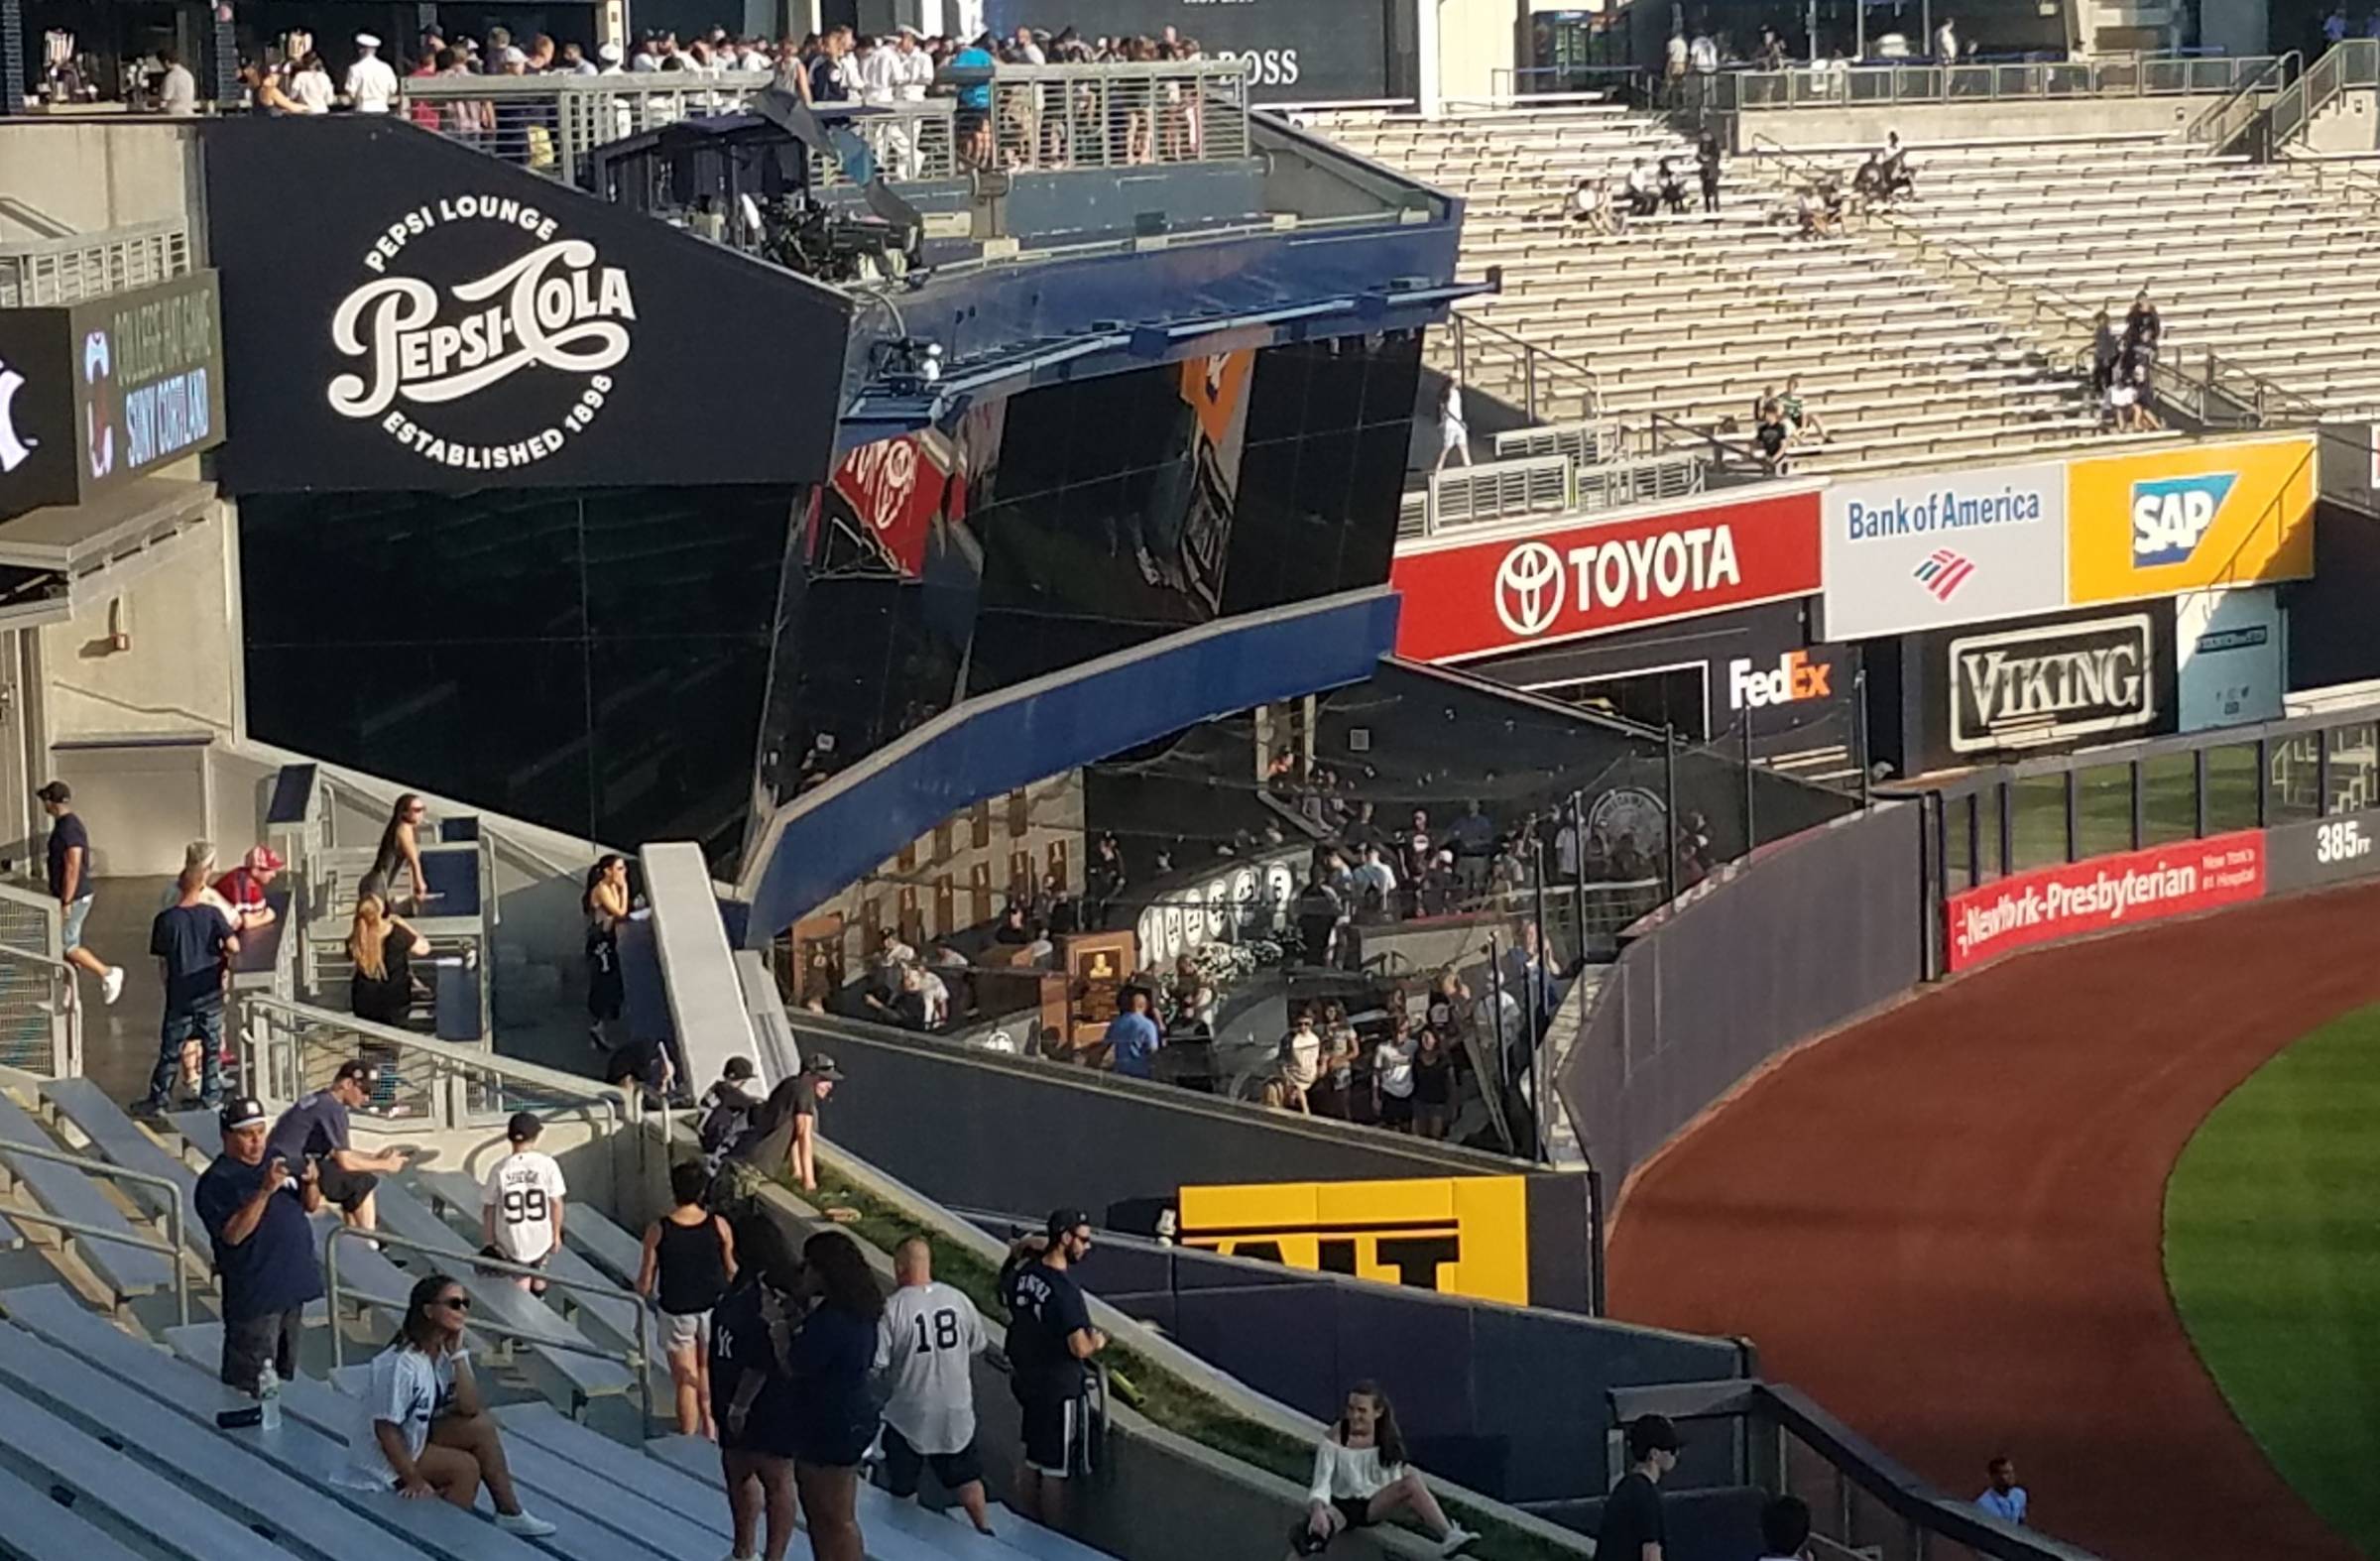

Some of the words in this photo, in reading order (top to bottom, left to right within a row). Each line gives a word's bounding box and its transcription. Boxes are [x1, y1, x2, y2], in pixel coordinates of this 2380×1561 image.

[365, 205, 435, 273] PEPSI
[439, 195, 559, 241] LOUNGE
[382, 411, 565, 469] ESTABLISHED
[564, 374, 613, 433] 1898
[1847, 497, 1909, 540] Bank
[1913, 493, 1938, 532] of
[1941, 486, 2040, 530] America
[2135, 490, 2213, 553] SAP
[1568, 525, 1740, 611] TOYOTA
[1729, 651, 1831, 710] FedEx
[1961, 643, 2140, 726] VIKING
[504, 1189, 546, 1225] 99
[914, 1307, 958, 1354] 18
